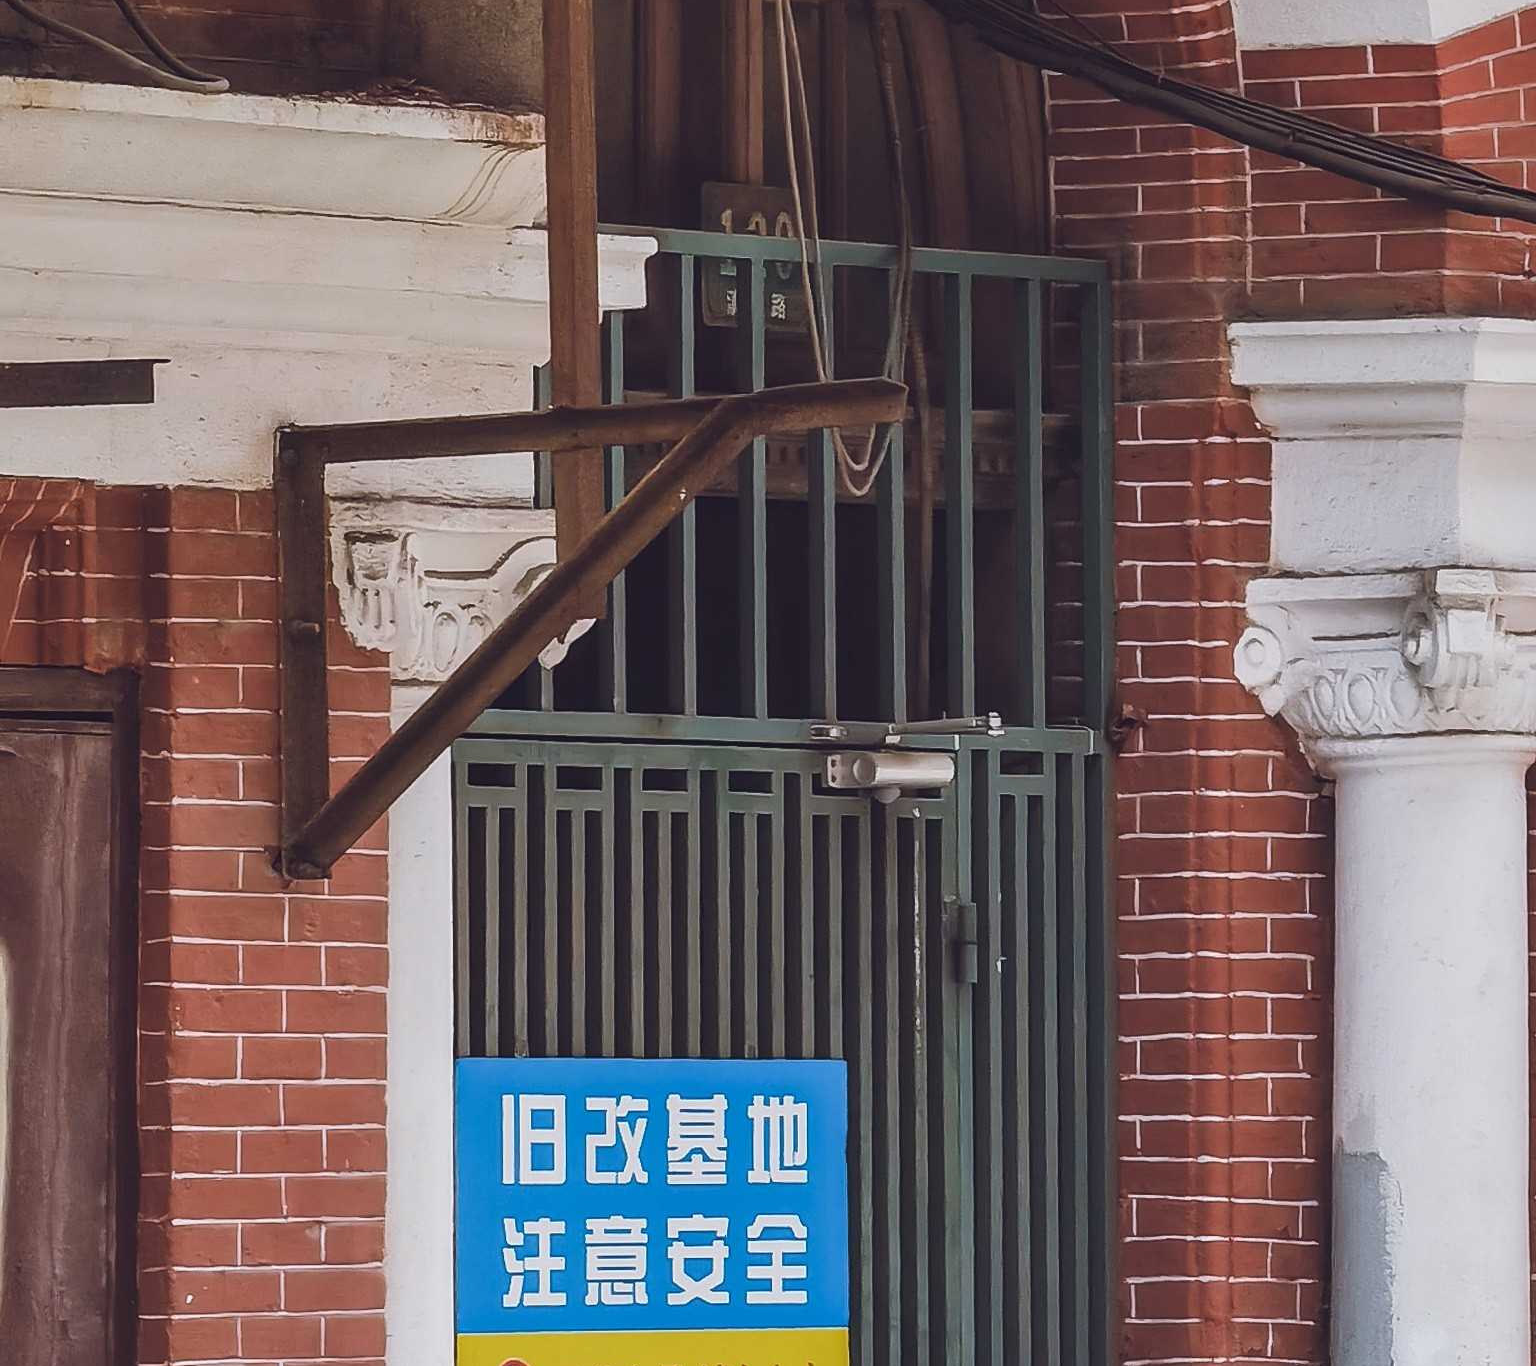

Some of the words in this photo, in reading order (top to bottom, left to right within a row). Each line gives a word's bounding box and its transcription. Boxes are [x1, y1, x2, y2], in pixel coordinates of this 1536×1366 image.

[501, 1093, 809, 1186] 旧改基地
[502, 1213, 809, 1308] 注意安全
